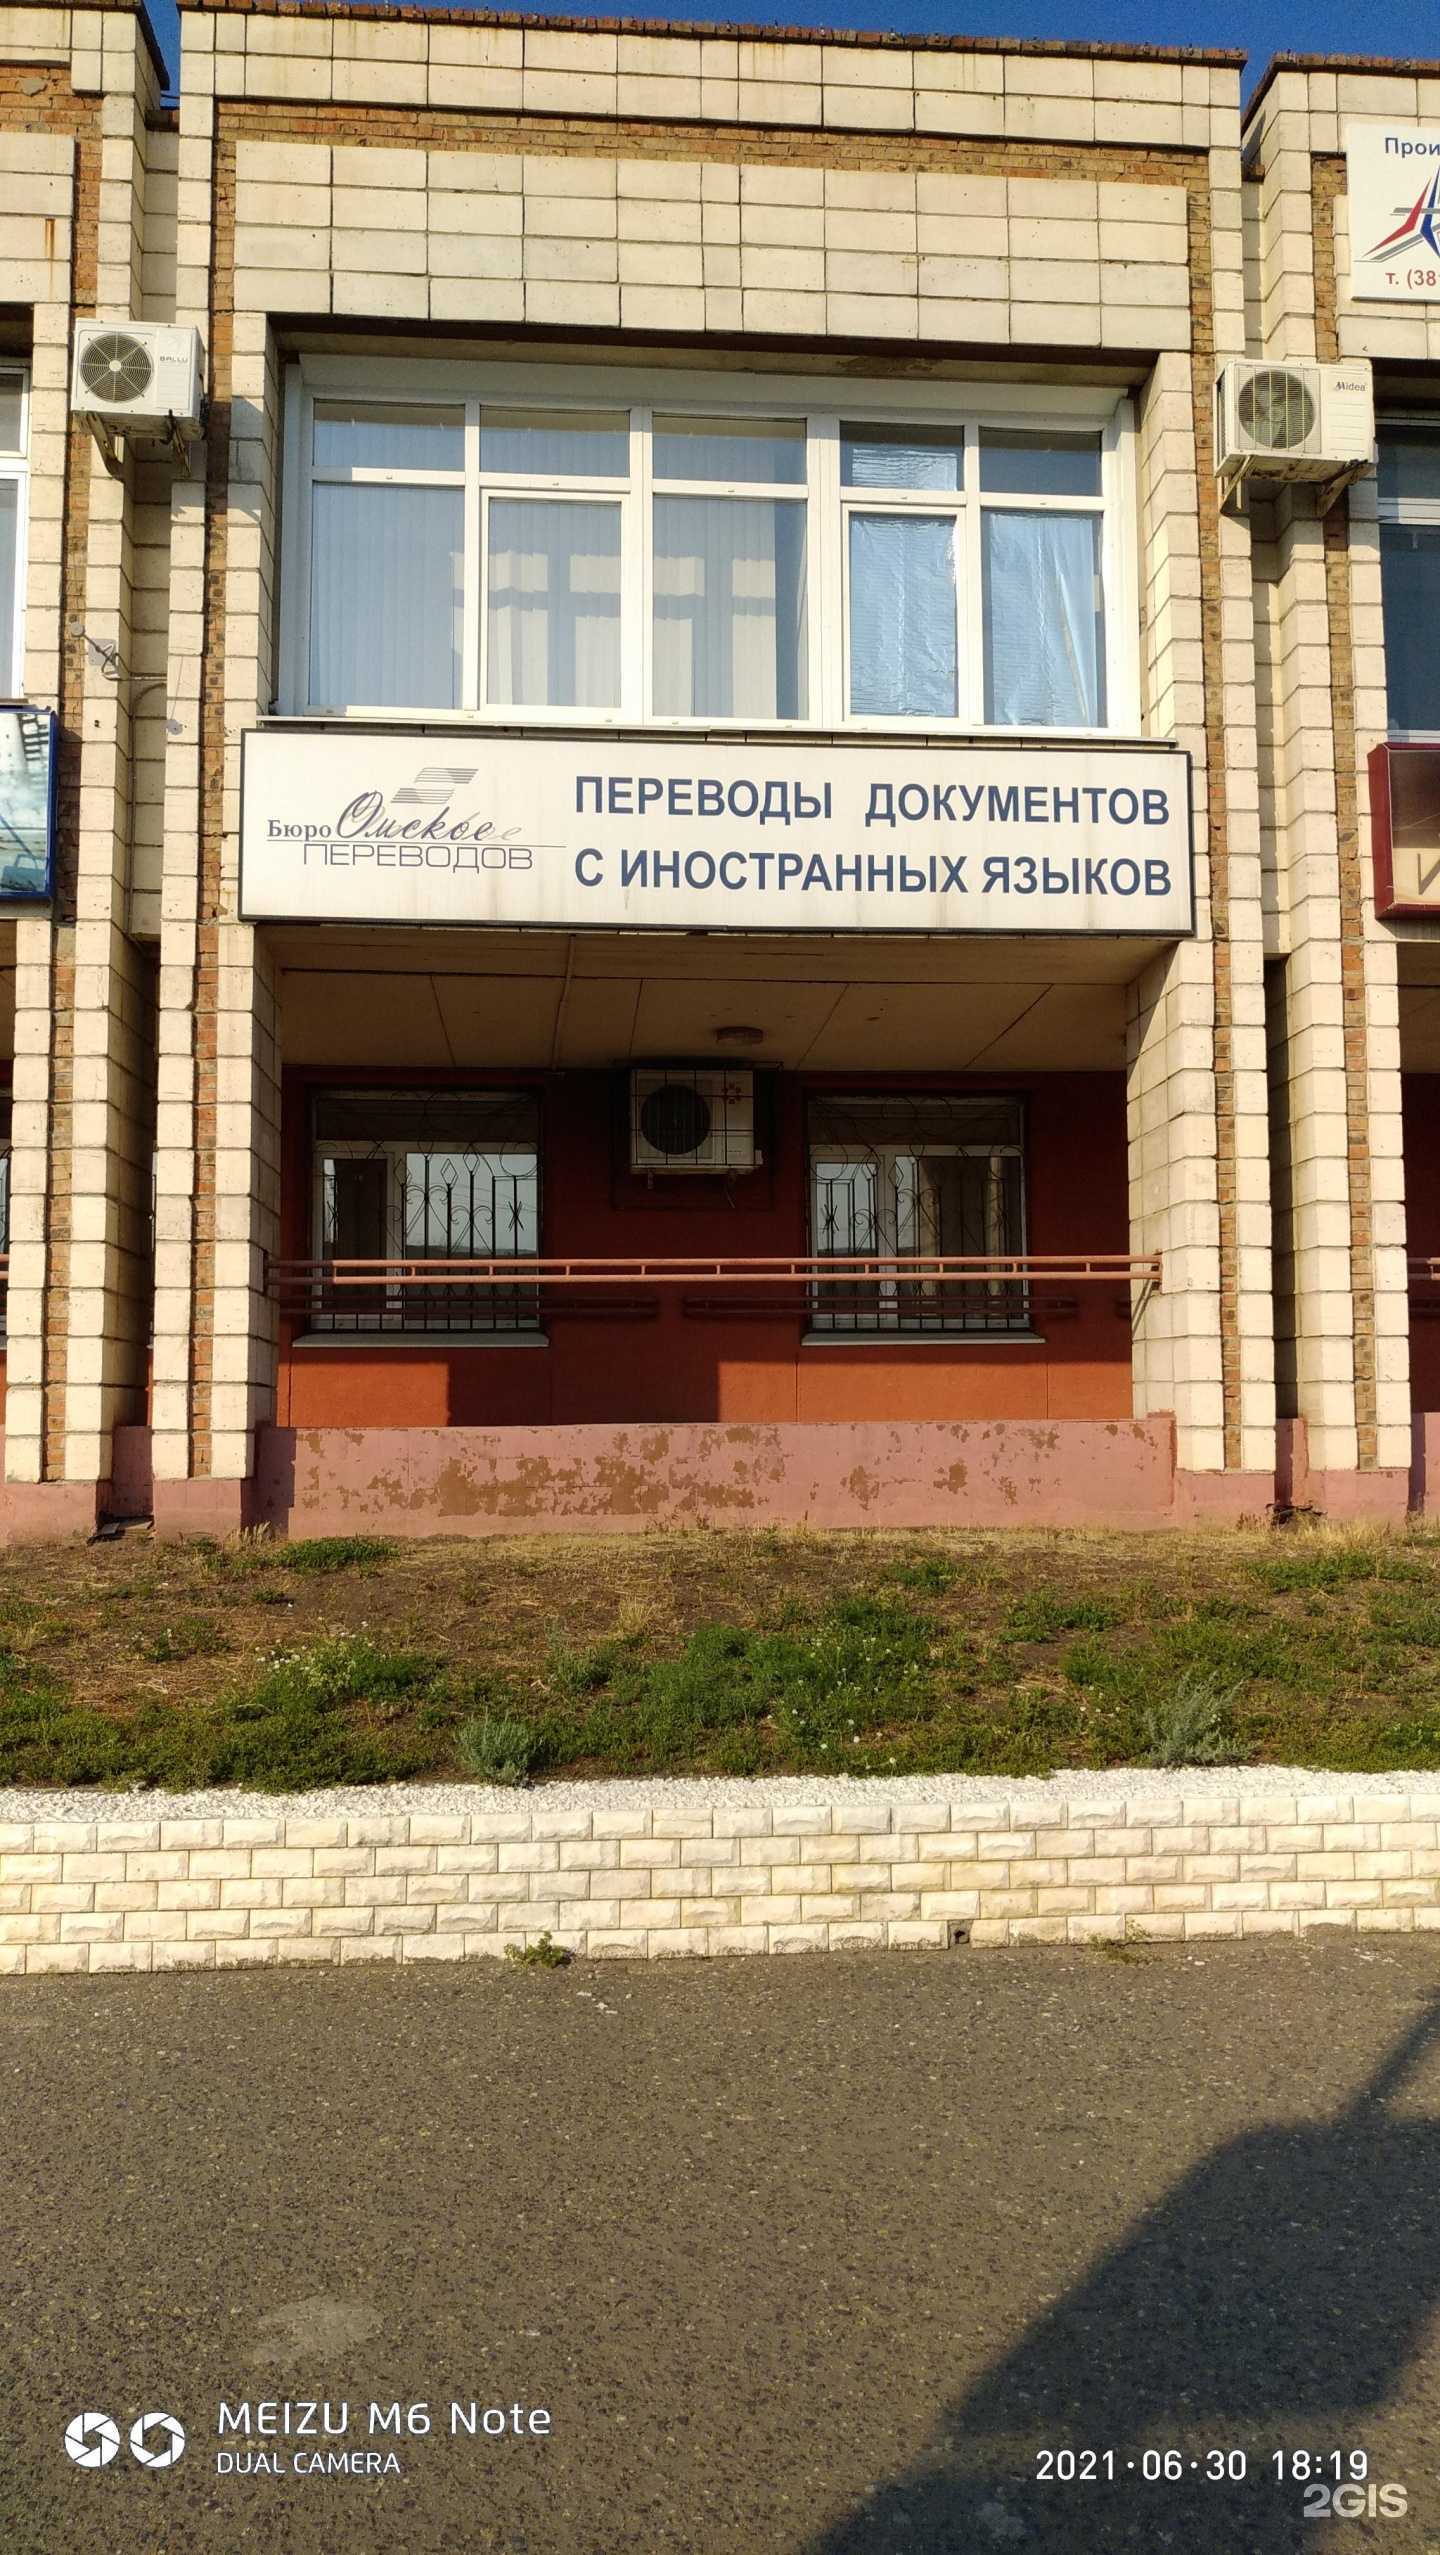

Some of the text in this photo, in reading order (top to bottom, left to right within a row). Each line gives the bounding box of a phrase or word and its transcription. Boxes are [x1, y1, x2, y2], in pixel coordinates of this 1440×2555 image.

[1407, 269, 1440, 290] (38
[267, 790, 493, 842] Бюро Омское
[576, 775, 1170, 828] ПЕРЕВОДЫ ДОКУМЕНТОВ
[304, 843, 533, 874] ПЕРЕВОДОВ
[575, 847, 1172, 896] С ИНОСТРАННЫХ ЯЗЫКОВ
